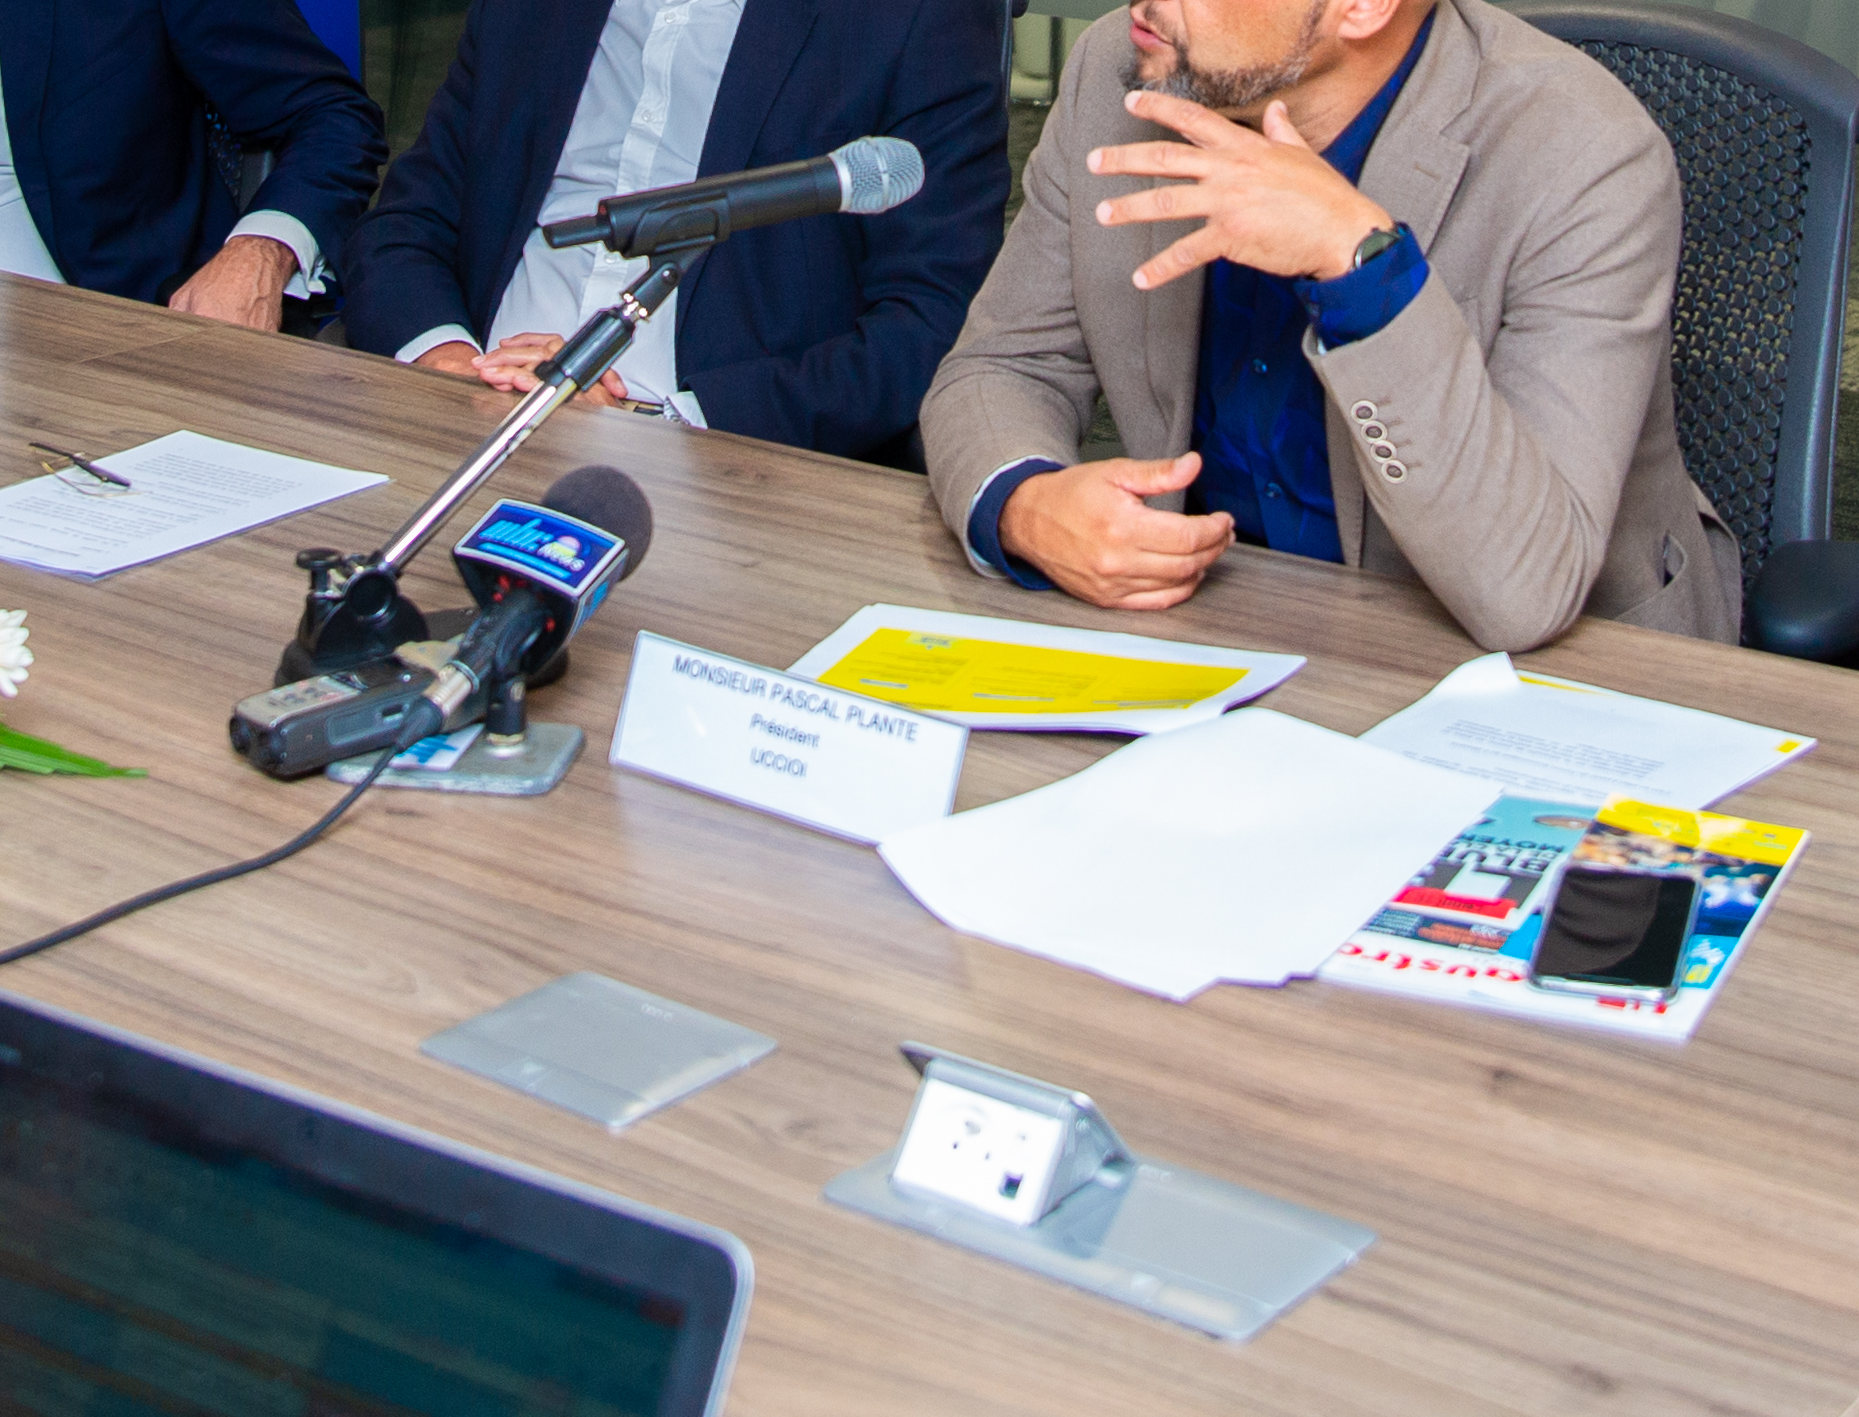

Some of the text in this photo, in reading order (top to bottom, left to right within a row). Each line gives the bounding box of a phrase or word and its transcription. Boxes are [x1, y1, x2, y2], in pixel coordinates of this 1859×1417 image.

[672, 654, 920, 742] MONSIEUR PASCAL PLANTE
[750, 713, 819, 748] Président
